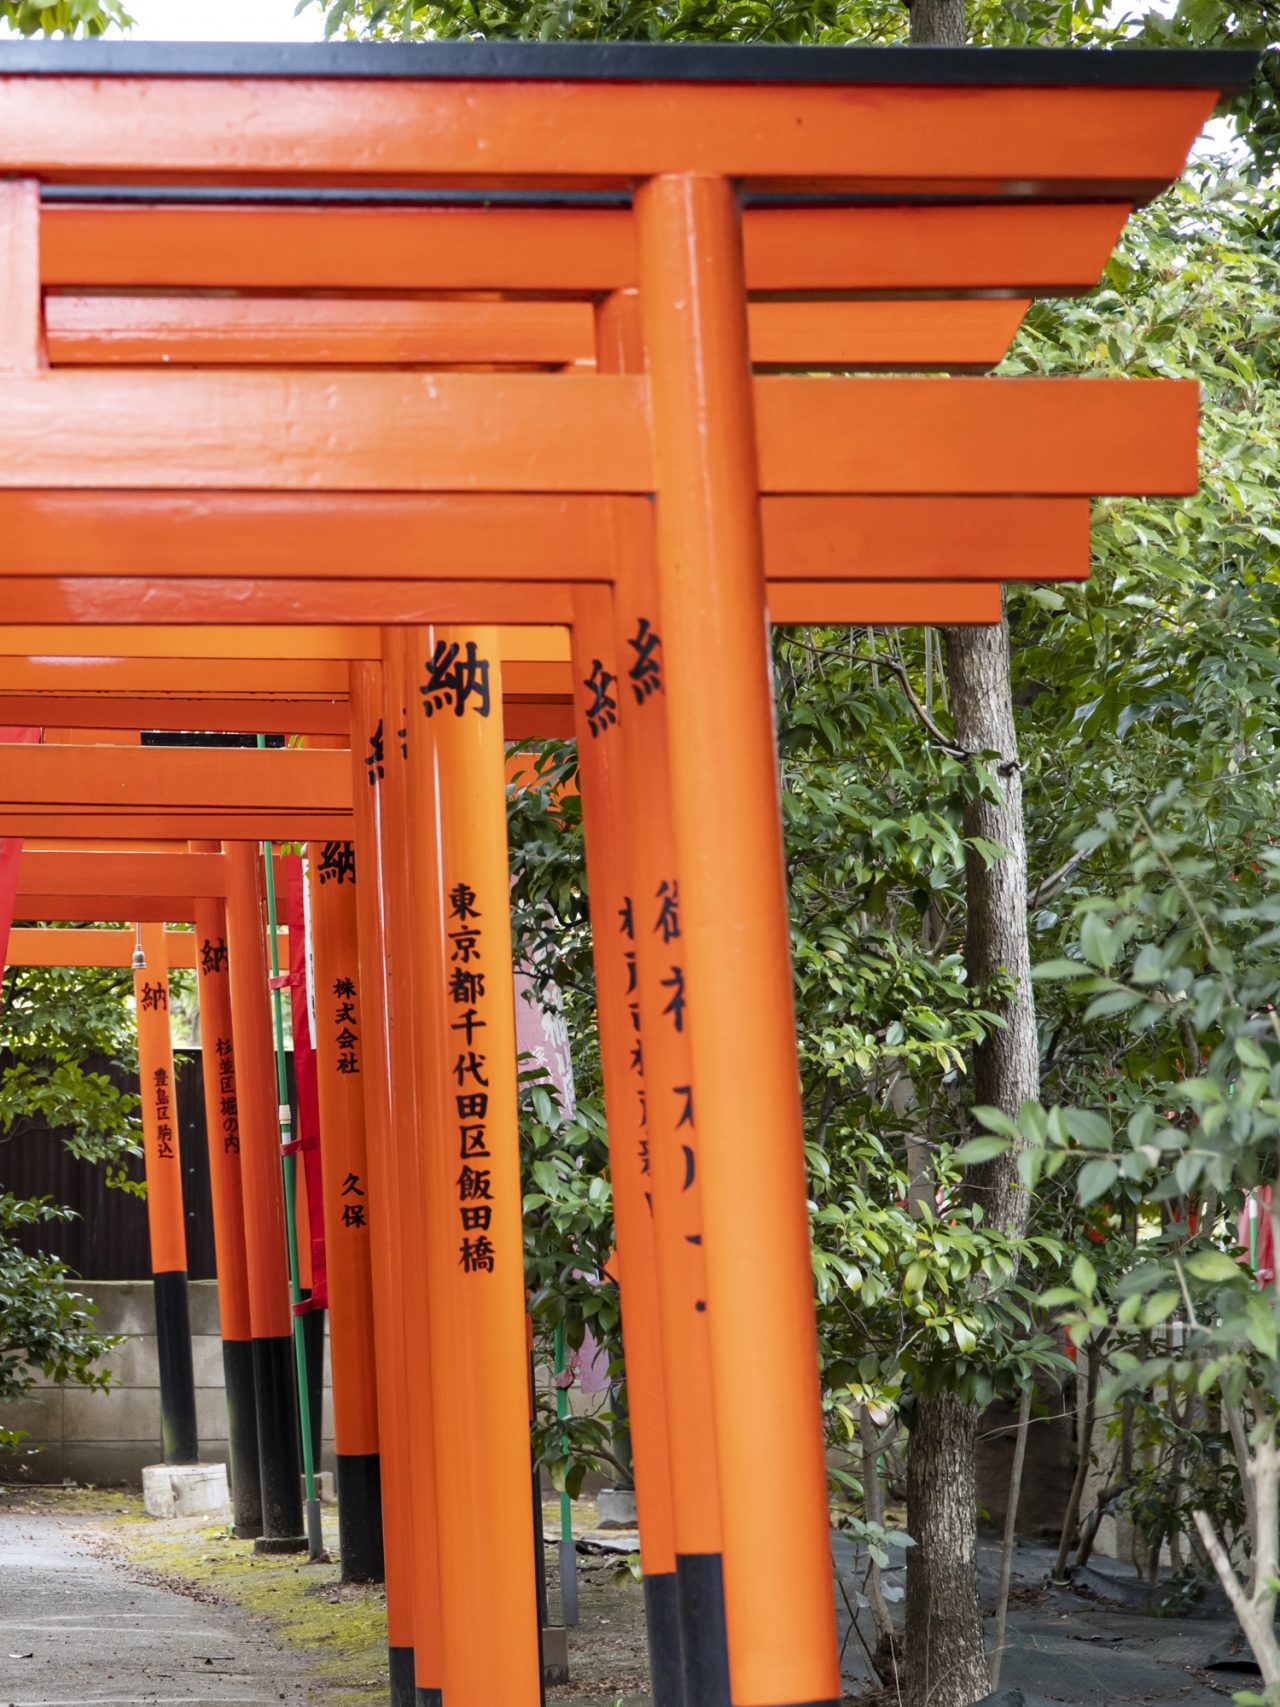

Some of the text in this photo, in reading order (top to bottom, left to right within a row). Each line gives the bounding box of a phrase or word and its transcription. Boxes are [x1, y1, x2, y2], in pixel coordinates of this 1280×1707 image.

[420, 640, 491, 719] 納
[140, 982, 167, 1011] 納
[153, 1067, 175, 1159] 豊島区駒込
[216, 1037, 240, 1154] 杉並区堀の内
[333, 977, 367, 1228] 株式会社 久保
[447, 883, 495, 1274] 東京都千代田区飯田橋
